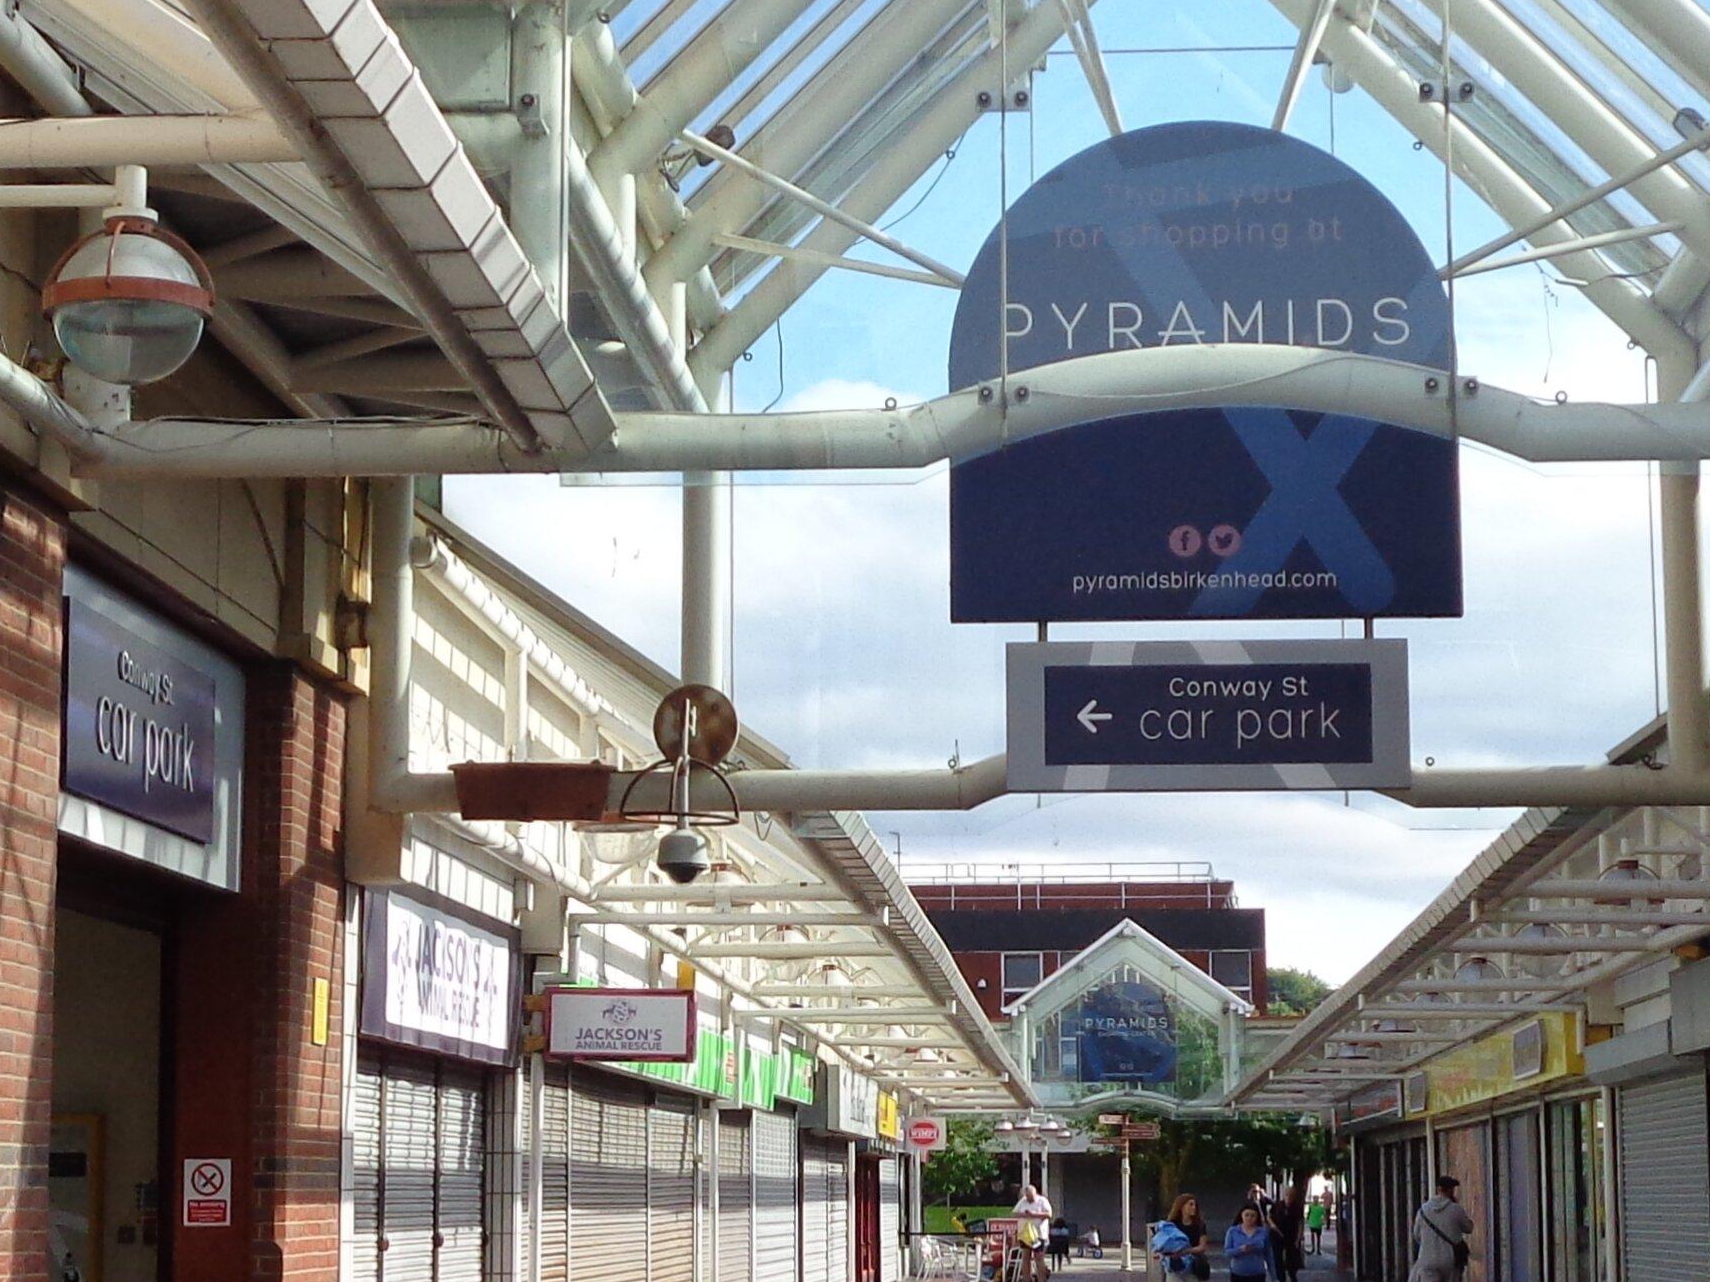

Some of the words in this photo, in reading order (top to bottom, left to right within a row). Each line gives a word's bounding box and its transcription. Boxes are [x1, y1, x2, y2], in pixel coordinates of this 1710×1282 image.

[1231, 185, 1294, 212] you
[1054, 225, 1105, 250] for
[1119, 220, 1289, 250] shopping
[1308, 216, 1343, 240] at
[1001, 296, 1412, 350] PYRAMIDS
[1072, 569, 1338, 595] pyramidsbirkenhead.com
[117, 650, 161, 706] Conway
[1168, 676, 1272, 701] Conway
[1282, 675, 1309, 697] St
[1138, 702, 1213, 741] car
[1236, 700, 1342, 750] park
[95, 692, 138, 767] car
[143, 716, 196, 794] park
[575, 1027, 662, 1041] JACKSON'S
[1085, 1017, 1169, 1030] PYRAMIDS
[575, 1040, 619, 1051] ANIMAL
[620, 1041, 662, 1051] RESCUE
